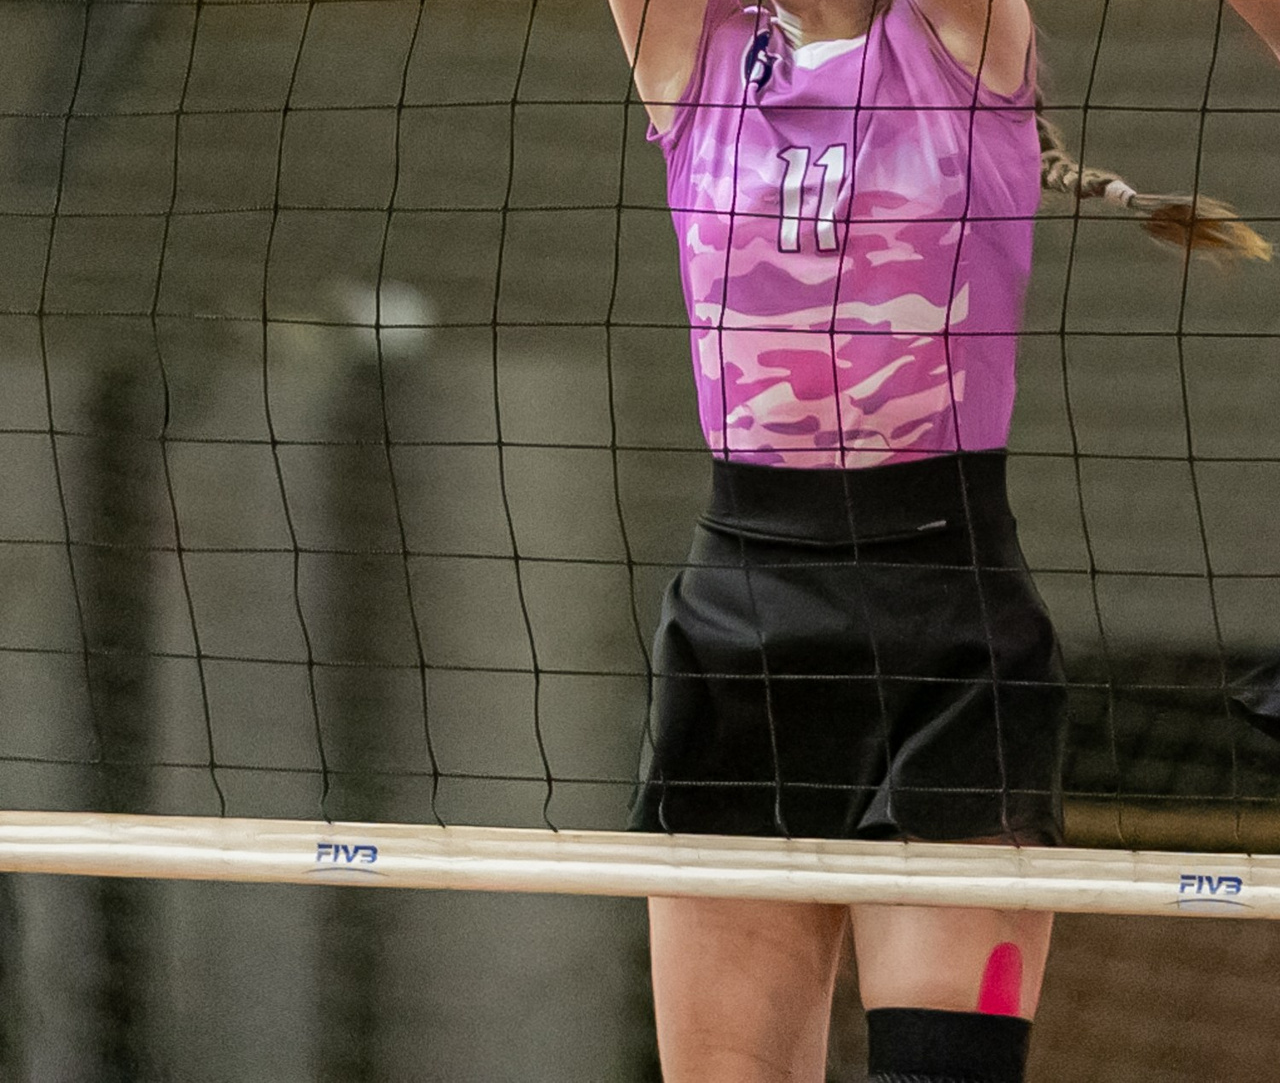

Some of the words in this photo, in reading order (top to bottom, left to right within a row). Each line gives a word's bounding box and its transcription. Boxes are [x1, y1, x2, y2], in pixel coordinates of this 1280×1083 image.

[777, 143, 847, 253] 11
[316, 843, 378, 863] FIVB
[1180, 875, 1243, 895] FIVB
